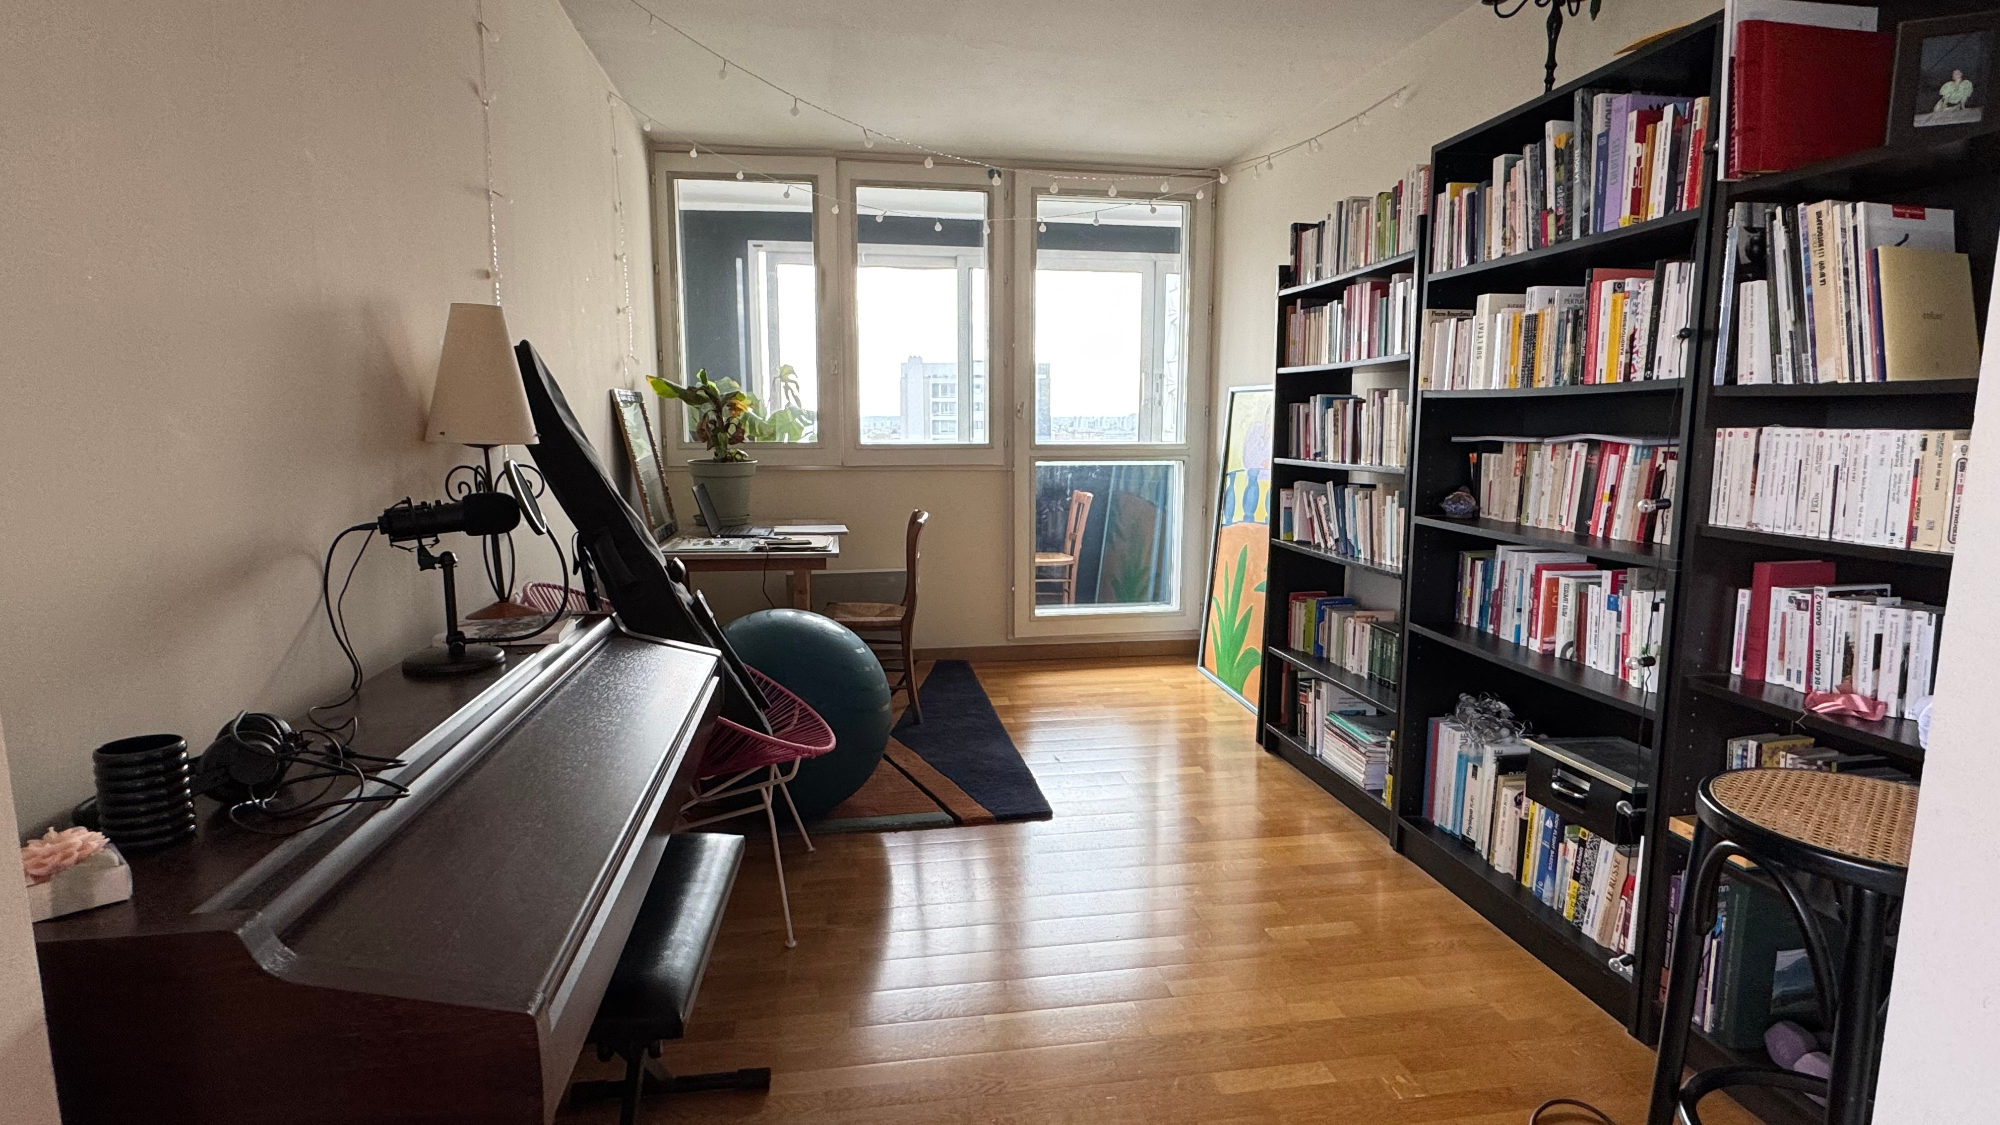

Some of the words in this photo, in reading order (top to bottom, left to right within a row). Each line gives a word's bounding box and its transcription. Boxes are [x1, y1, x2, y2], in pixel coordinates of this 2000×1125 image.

[1815, 676, 1821, 685] DE
[1466, 808, 1475, 836] Physique
[1576, 846, 1584, 865] chinois
[1607, 856, 1620, 888] RUSSE
[1605, 890, 1613, 902] LE
